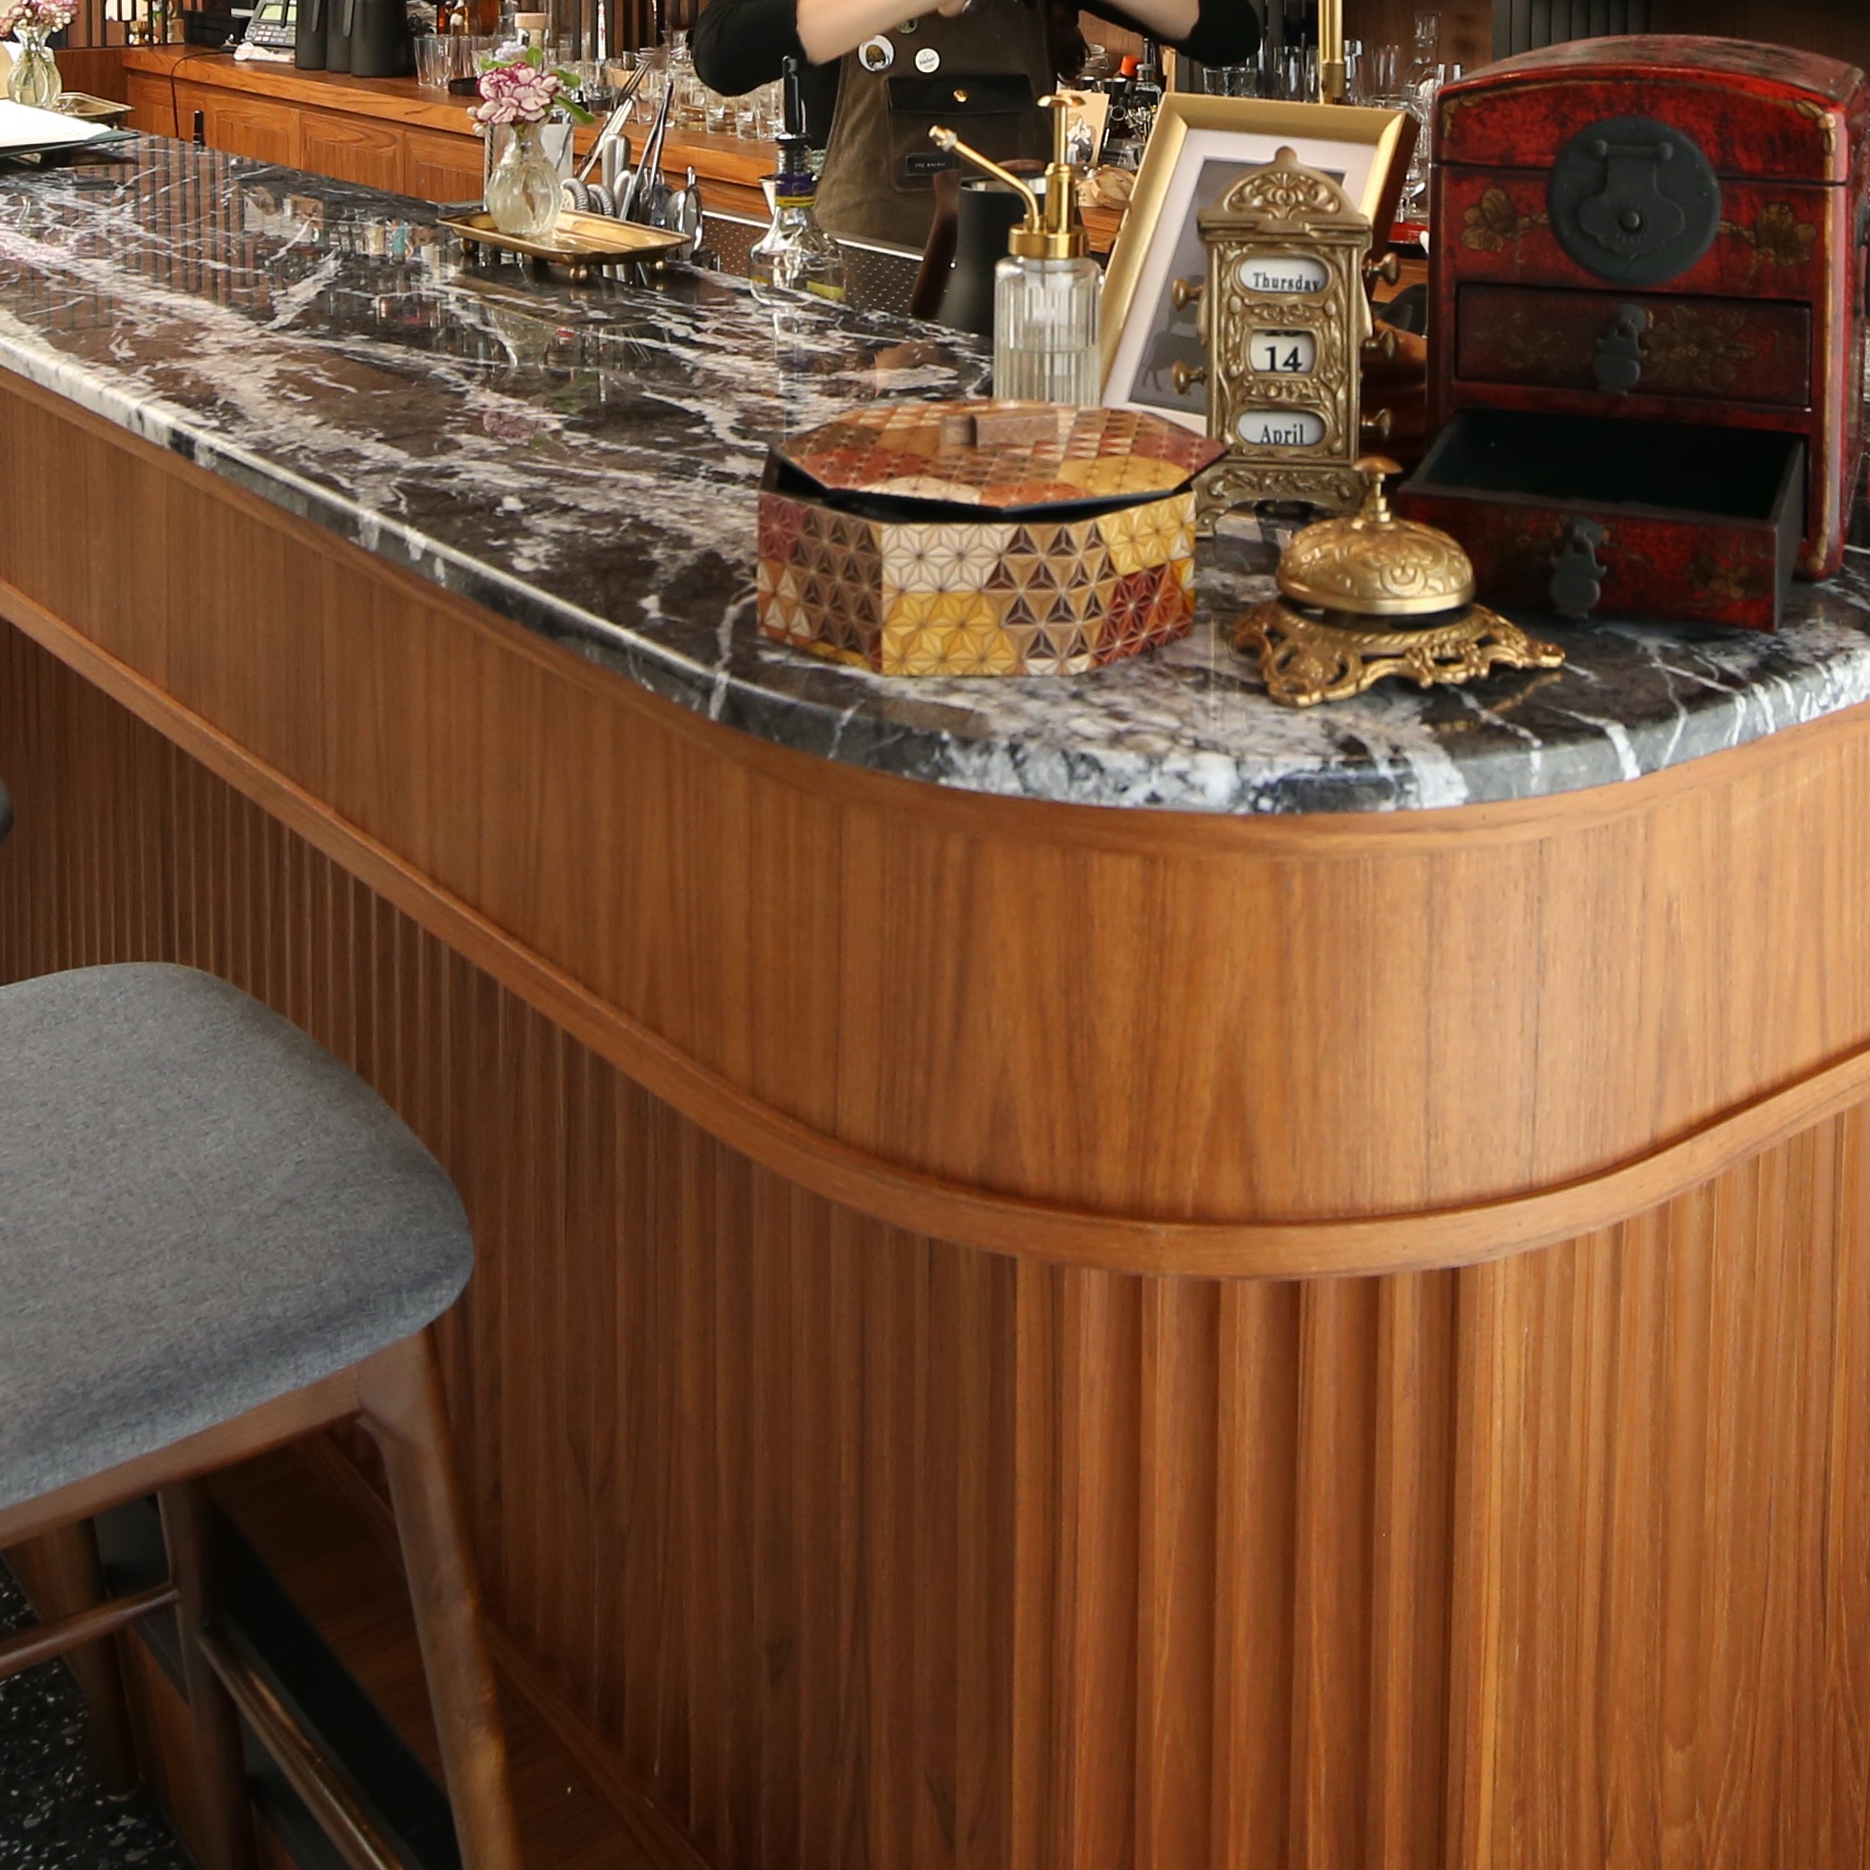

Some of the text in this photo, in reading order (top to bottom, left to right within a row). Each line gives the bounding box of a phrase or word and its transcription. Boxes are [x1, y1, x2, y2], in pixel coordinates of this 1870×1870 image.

[1253, 272, 1321, 292] Thursday
[1264, 345, 1303, 373] 14
[1260, 424, 1305, 445] April
